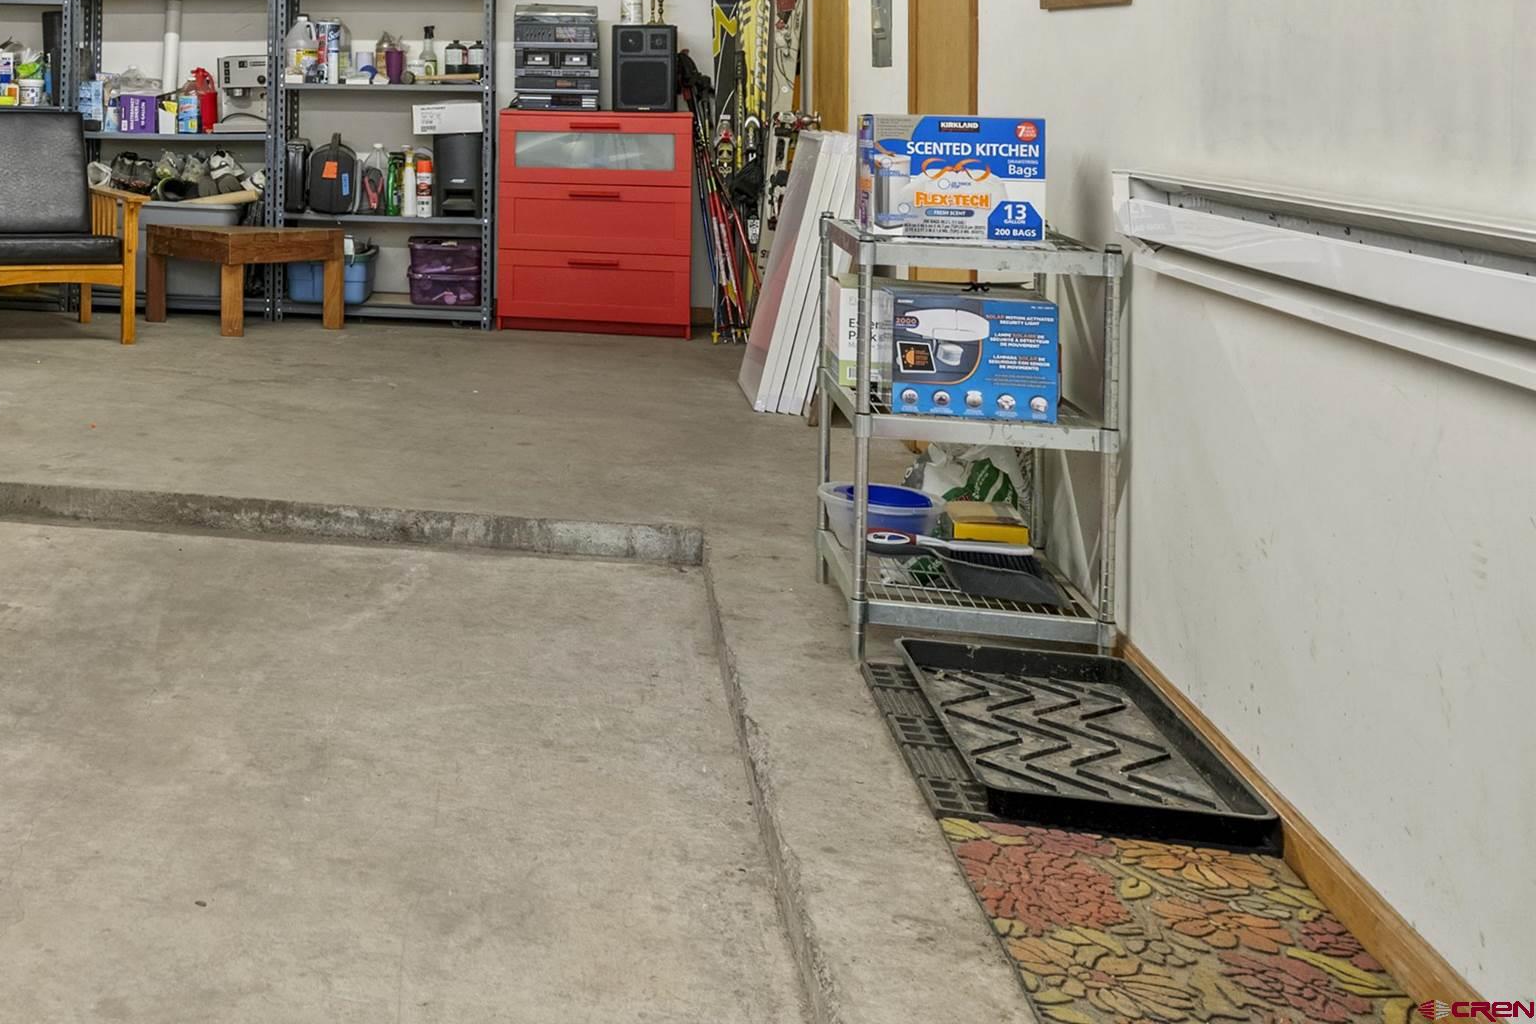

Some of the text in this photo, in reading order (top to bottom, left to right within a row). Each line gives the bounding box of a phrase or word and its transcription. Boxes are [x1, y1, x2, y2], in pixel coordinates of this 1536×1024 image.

[940, 121, 979, 129] KIRKLAND
[906, 141, 1040, 158] SCENTED KITCHEN
[1008, 164, 1038, 178] Bags
[1004, 204, 1027, 220] 13
[994, 228, 1011, 236] 200
[1012, 229, 1037, 237] BAGS
